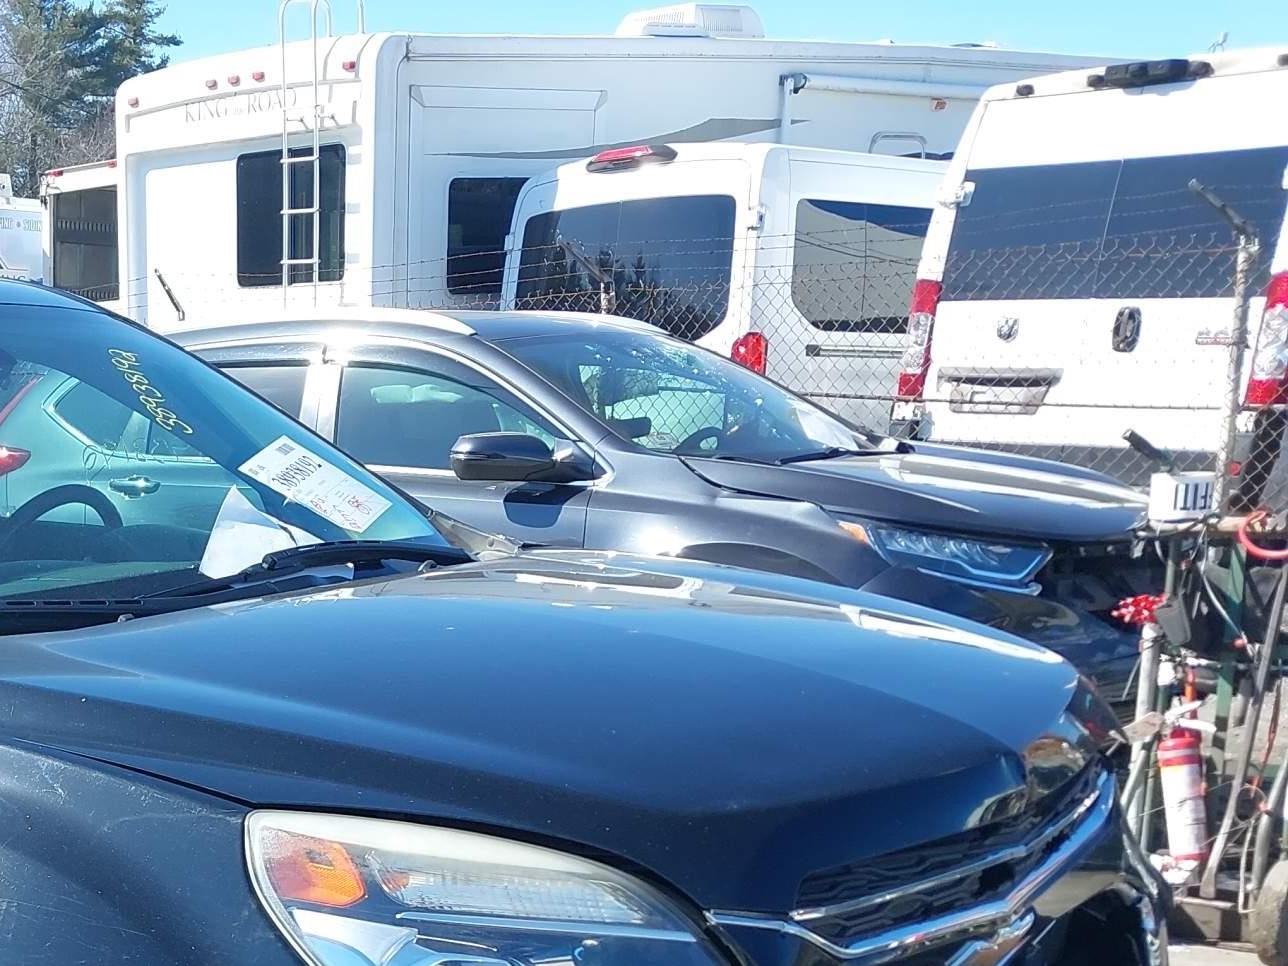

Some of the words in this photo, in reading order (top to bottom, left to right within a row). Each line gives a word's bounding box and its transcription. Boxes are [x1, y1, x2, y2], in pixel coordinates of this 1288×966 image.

[184, 99, 228, 123] KING
[246, 87, 298, 115] ROAD
[270, 454, 323, 491] 38938192
